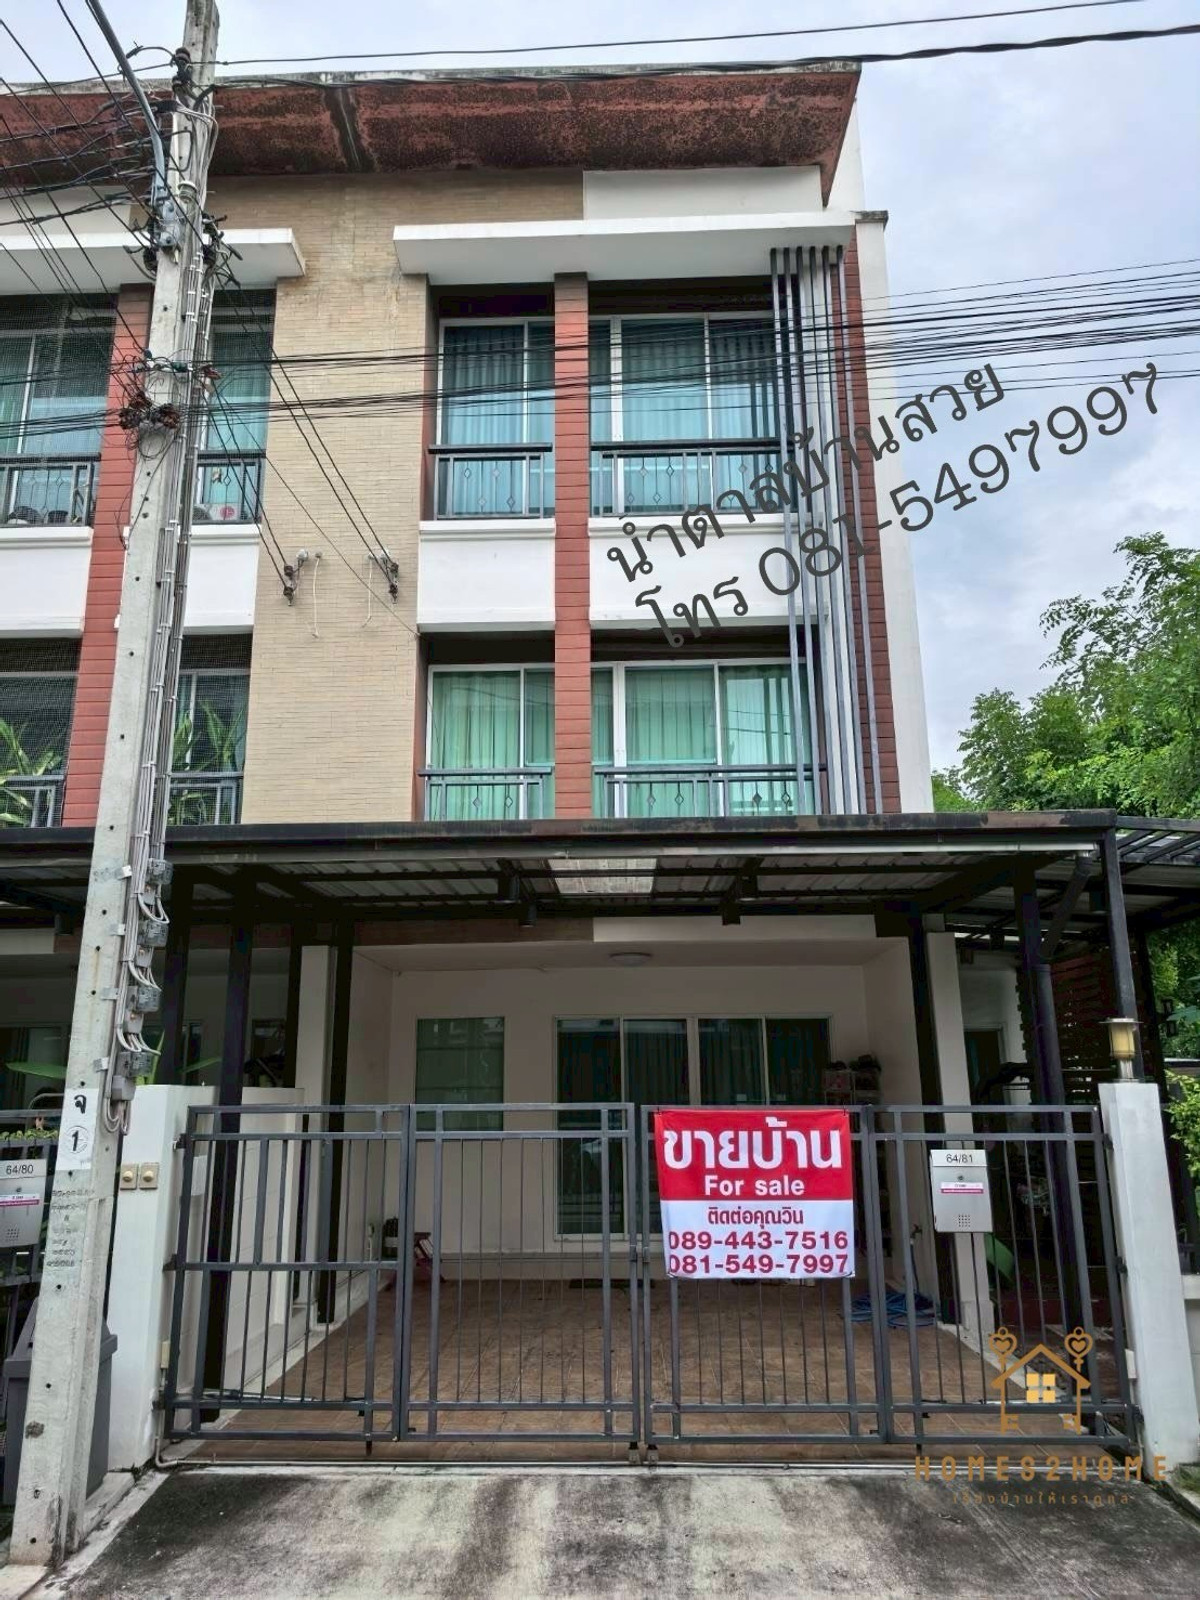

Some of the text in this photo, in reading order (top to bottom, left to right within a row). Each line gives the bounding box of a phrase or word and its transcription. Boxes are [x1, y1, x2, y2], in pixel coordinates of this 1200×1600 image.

[663, 1116, 842, 1169] ขายบ้าน
[945, 1153, 973, 1164] 64/81
[6, 1164, 34, 1175] 64/80
[704, 1175, 805, 1196] For sale
[707, 1206, 804, 1229] ติดต่อคุณวิน
[668, 1231, 848, 1250] 089-443-7516
[669, 1254, 849, 1274] 081-549-7997
